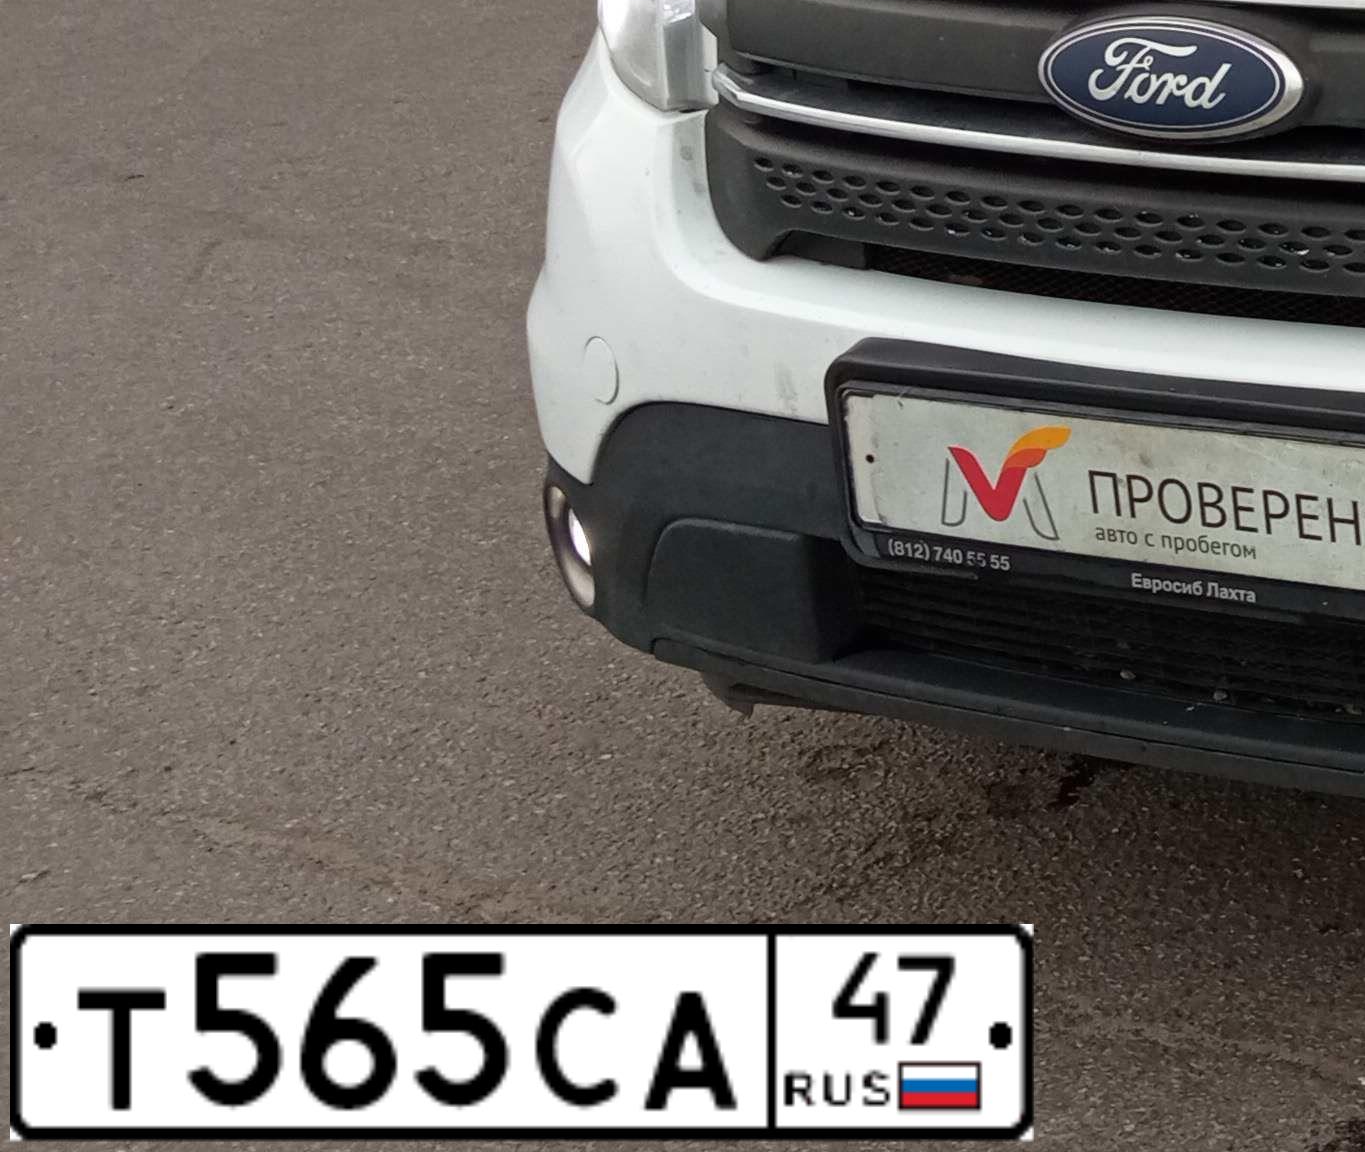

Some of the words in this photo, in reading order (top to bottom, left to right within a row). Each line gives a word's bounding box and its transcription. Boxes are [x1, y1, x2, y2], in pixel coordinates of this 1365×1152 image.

[1087, 37, 1232, 109] Ford
[887, 538, 930, 561] (812)
[933, 546, 963, 564] 740
[967, 551, 986, 568] 55
[989, 554, 1011, 571] 55
[1094, 526, 1138, 546] авто
[1144, 531, 1156, 547] с
[1161, 533, 1257, 560] пробегом
[1130, 572, 1203, 597] Евросиб
[1205, 581, 1257, 604] Лахта
